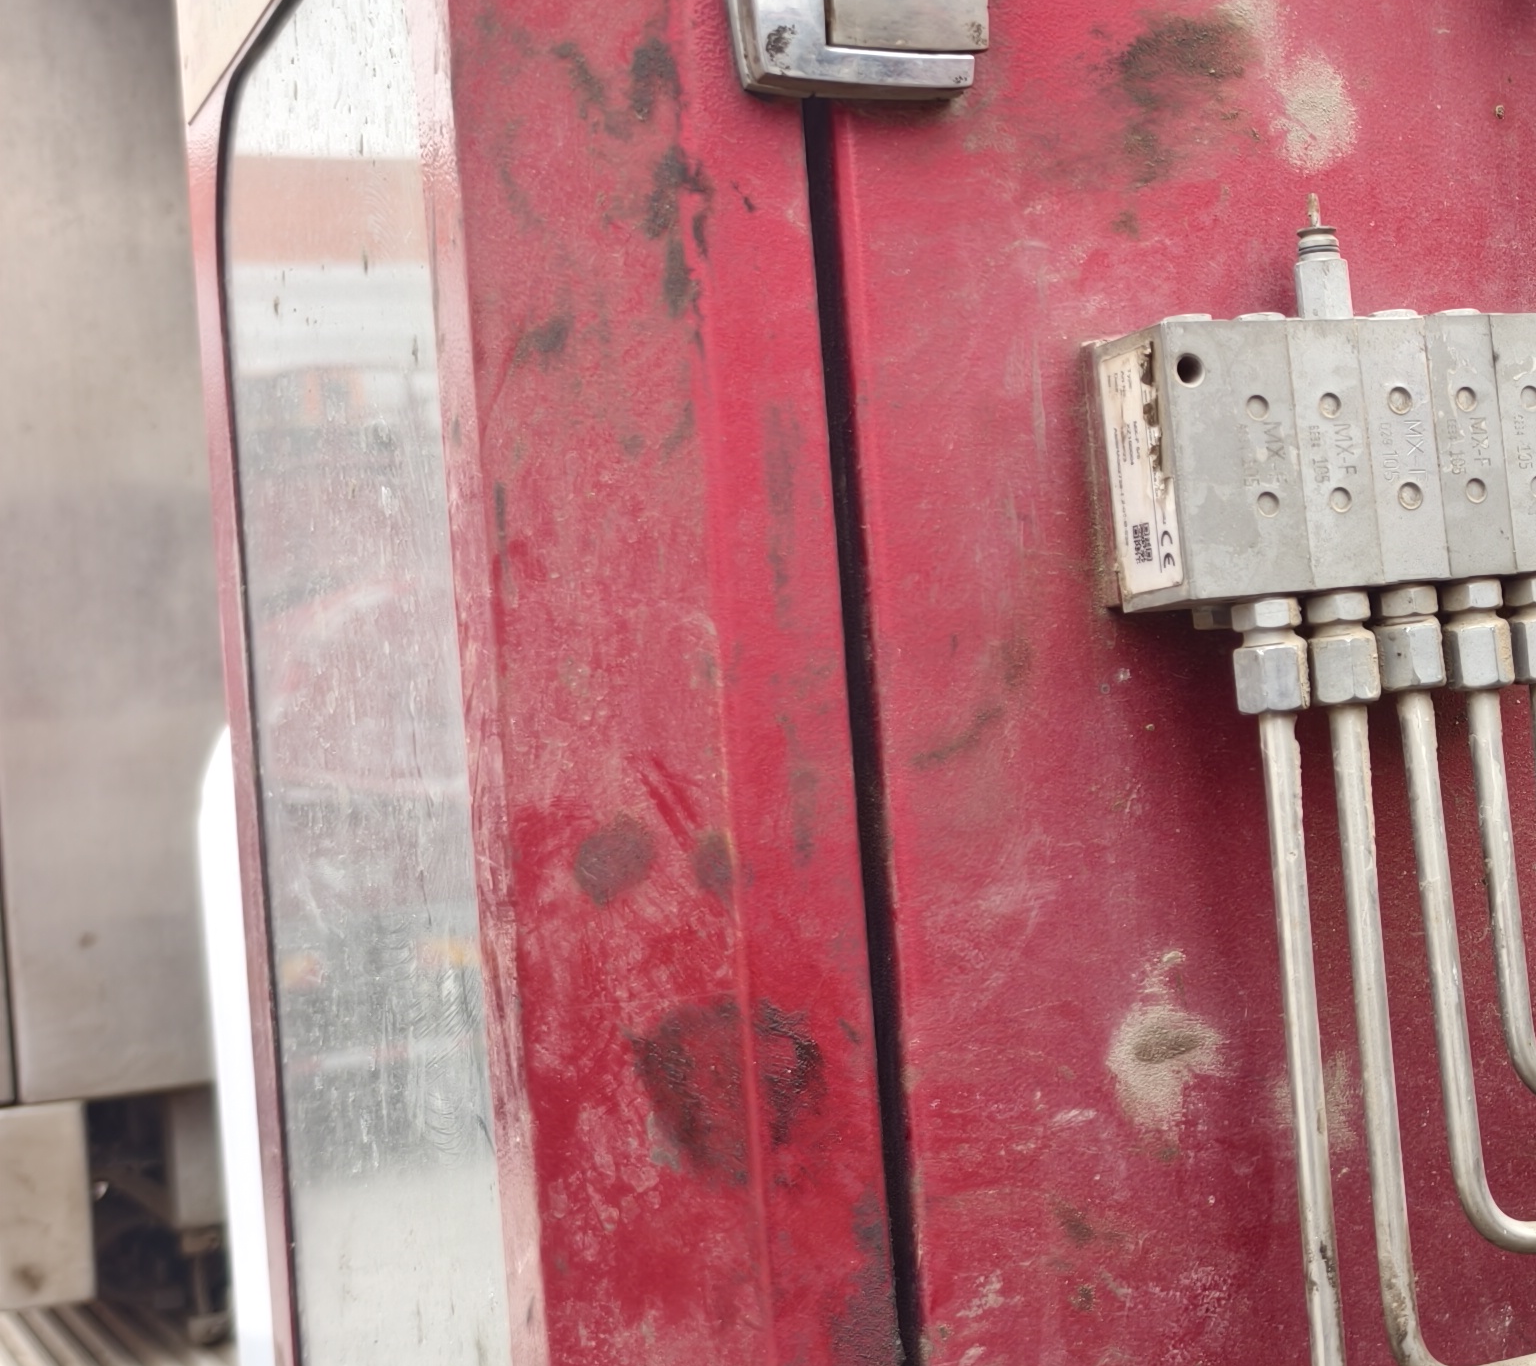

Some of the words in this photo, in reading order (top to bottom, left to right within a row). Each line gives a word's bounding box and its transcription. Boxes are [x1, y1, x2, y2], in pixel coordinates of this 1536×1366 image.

[1333, 423, 1358, 476] MX-F
[1403, 419, 1428, 483] MX-F
[1516, 444, 1534, 470] 105
[1312, 457, 1331, 484] 105
[1382, 450, 1401, 483] 105
